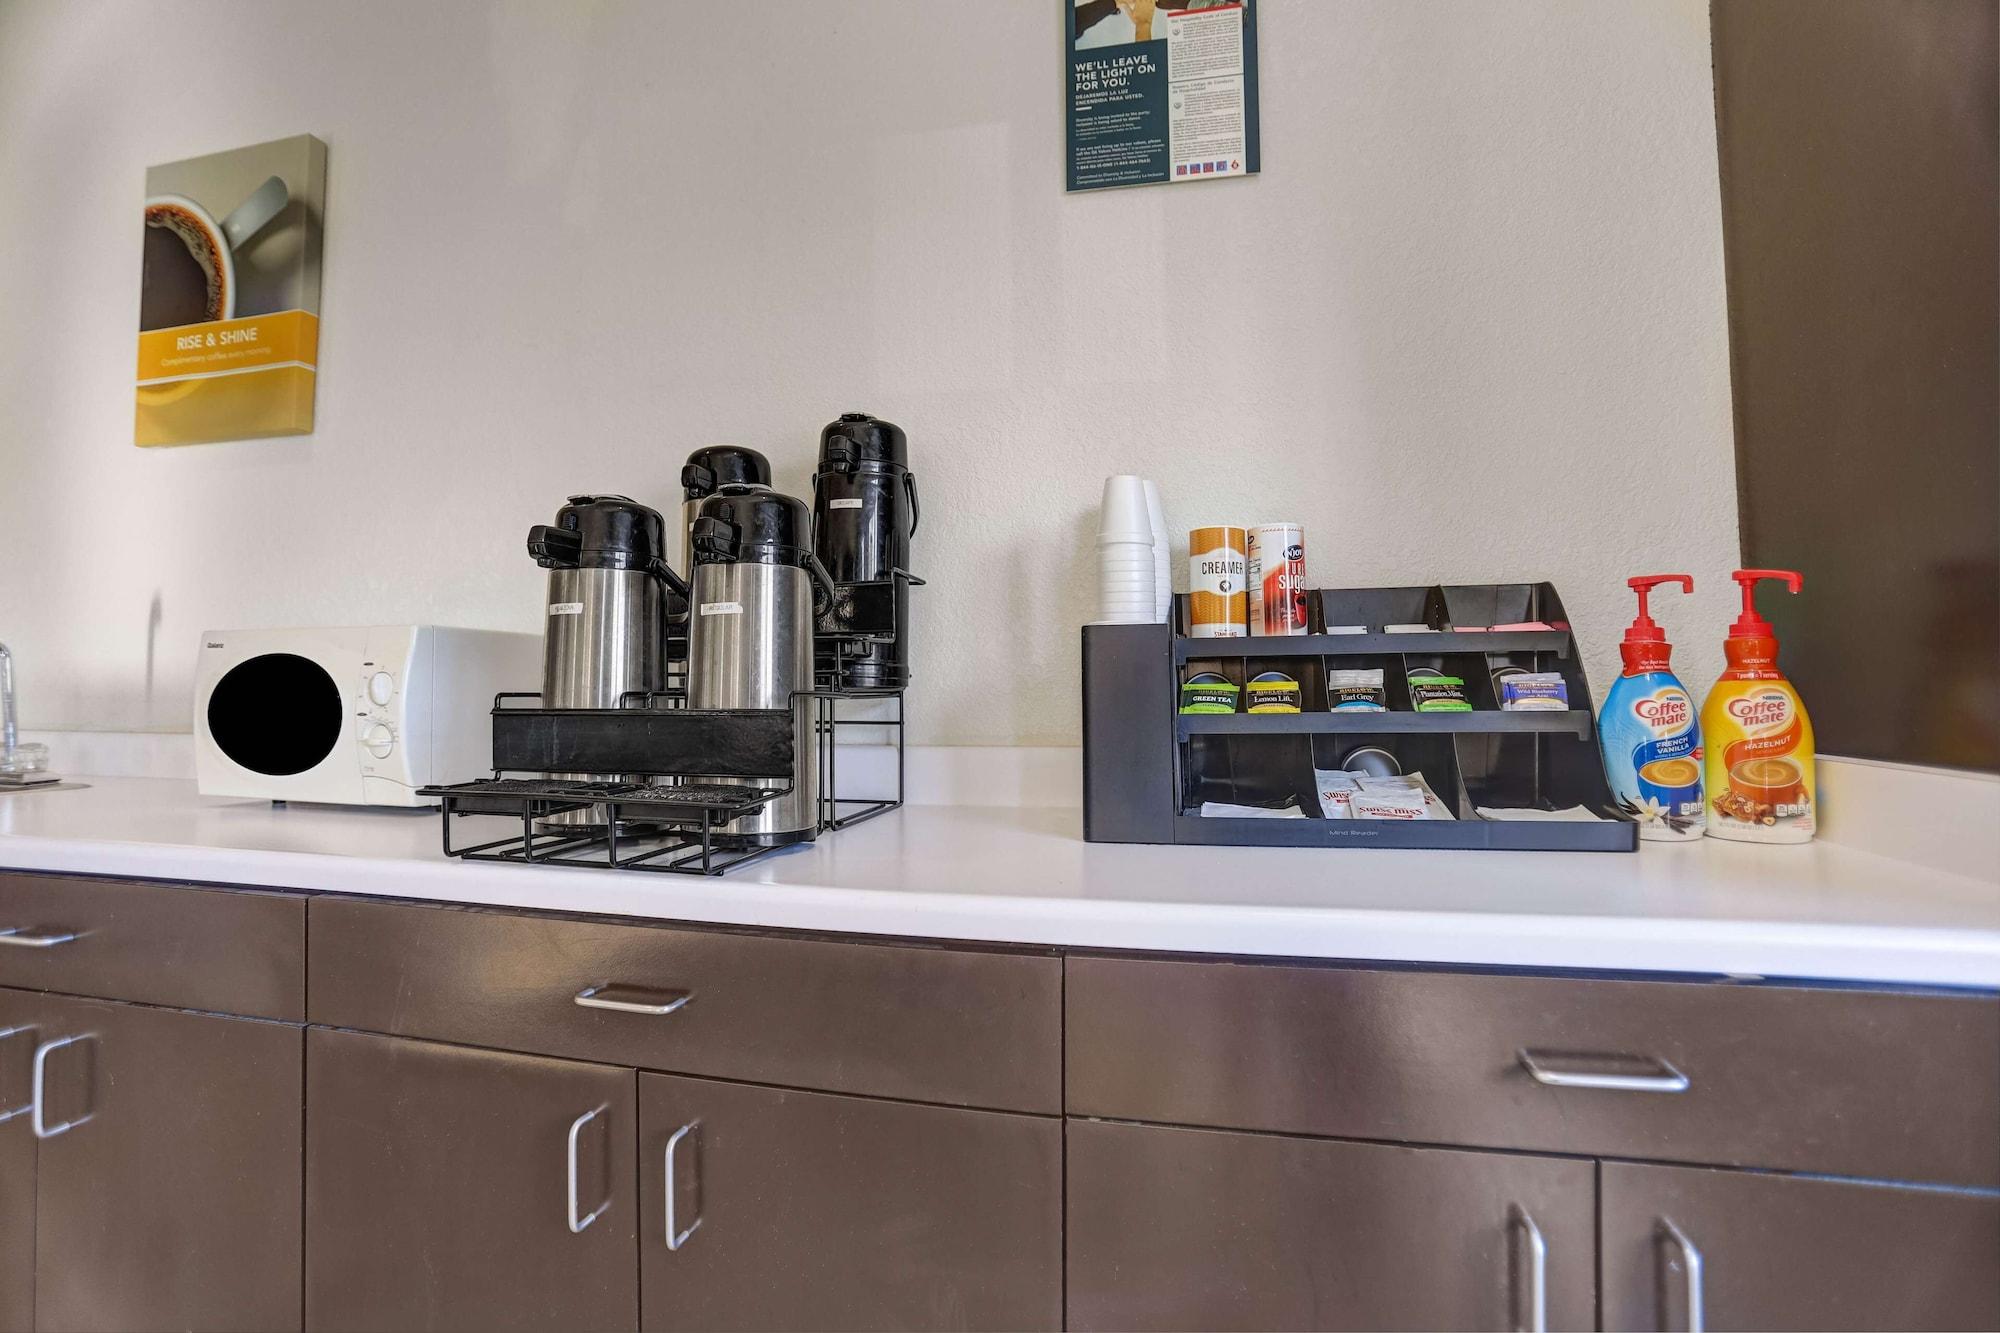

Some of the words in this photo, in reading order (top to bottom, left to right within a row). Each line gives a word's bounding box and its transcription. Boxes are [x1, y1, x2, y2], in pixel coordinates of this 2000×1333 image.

[1075, 60, 1108, 72] WE'LL
[1113, 55, 1148, 67] LEAVE
[1075, 71, 1096, 82] THE
[1101, 66, 1134, 78] LIGHT
[1138, 64, 1156, 74] ON
[1076, 81, 1098, 92] FOR
[1102, 77, 1130, 88] YOU.
[177, 334, 202, 350] RISE
[206, 332, 216, 347] &
[220, 328, 257, 345] SHINE
[1202, 561, 1244, 575] CREAMER
[1278, 574, 1305, 594] suga
[1635, 700, 1686, 718] Coffee
[1728, 698, 1785, 718] Coffee
[1652, 712, 1686, 727] mate
[1744, 712, 1785, 726] mate
[1656, 736, 1688, 748] FRENCH
[1656, 744, 1690, 754] VANILLA
[1744, 735, 1792, 750] HAZELNUT
